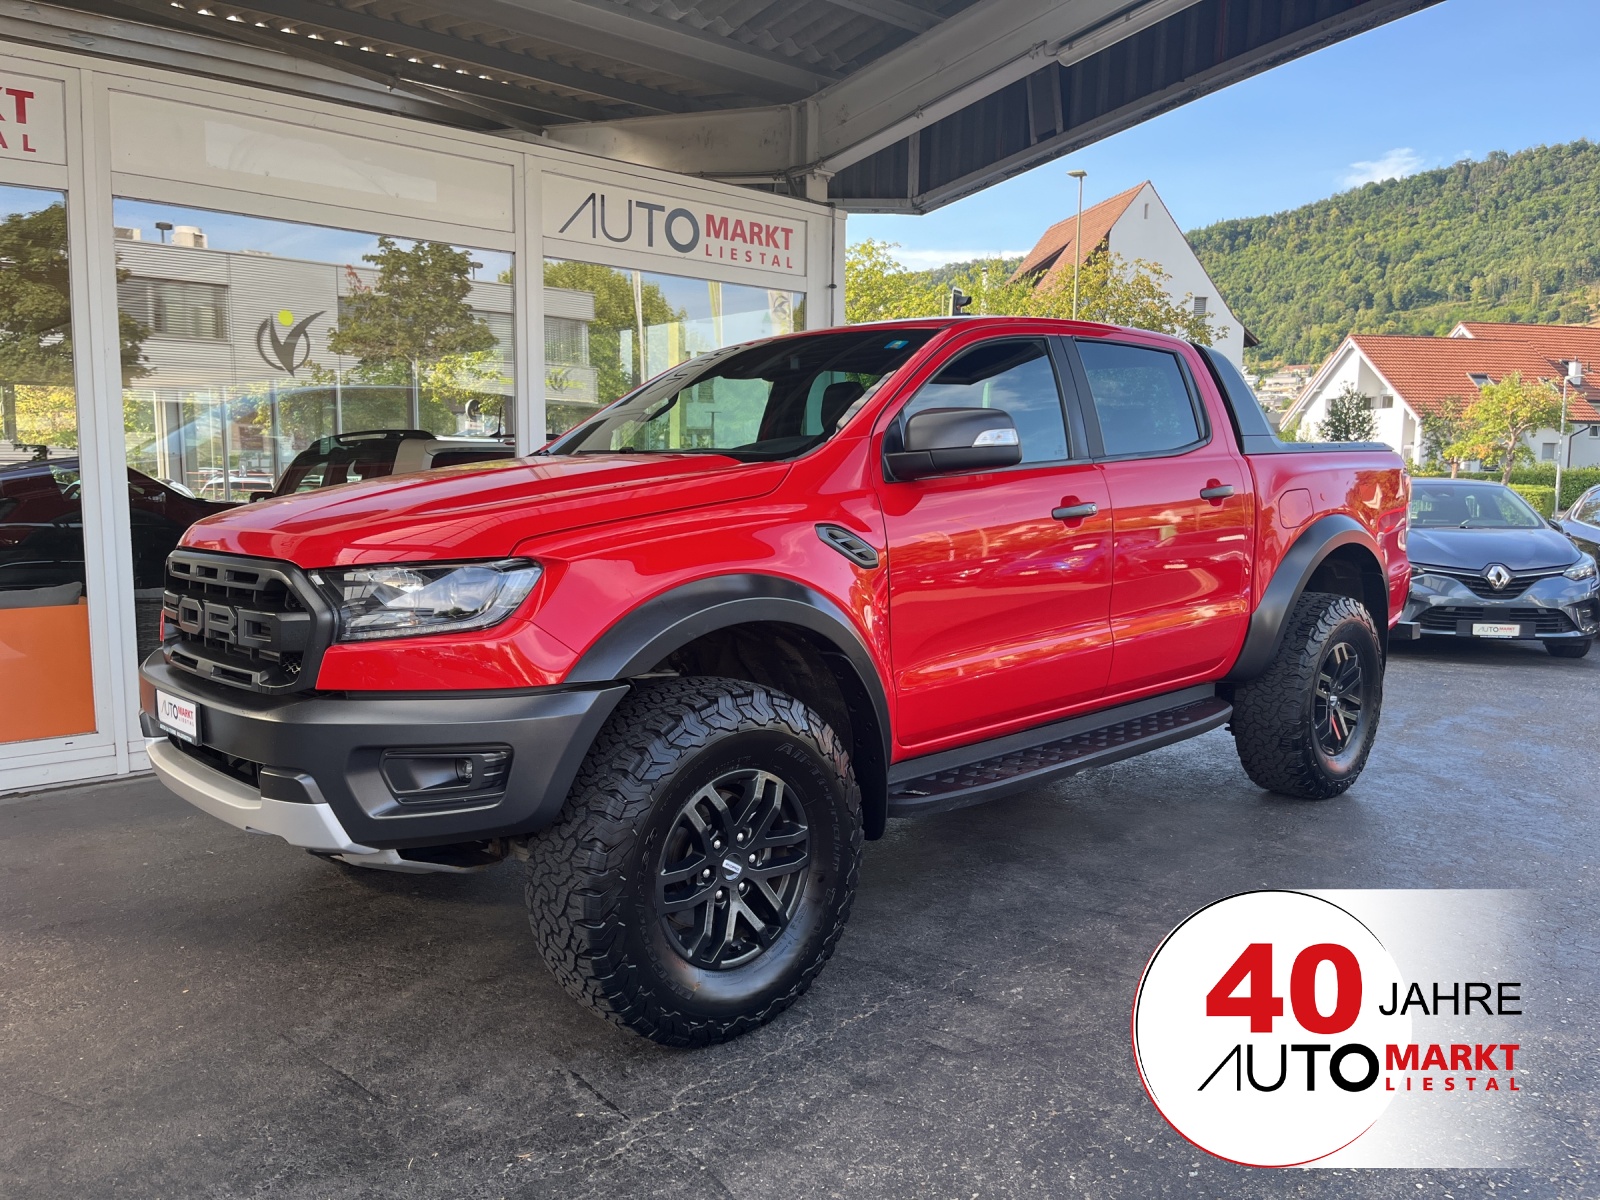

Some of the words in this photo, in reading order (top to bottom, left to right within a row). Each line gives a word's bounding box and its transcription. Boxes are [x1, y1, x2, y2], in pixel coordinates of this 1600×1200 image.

[558, 192, 700, 254] AUTO
[705, 213, 794, 251] MARKT
[705, 243, 793, 269] LIESTAL
